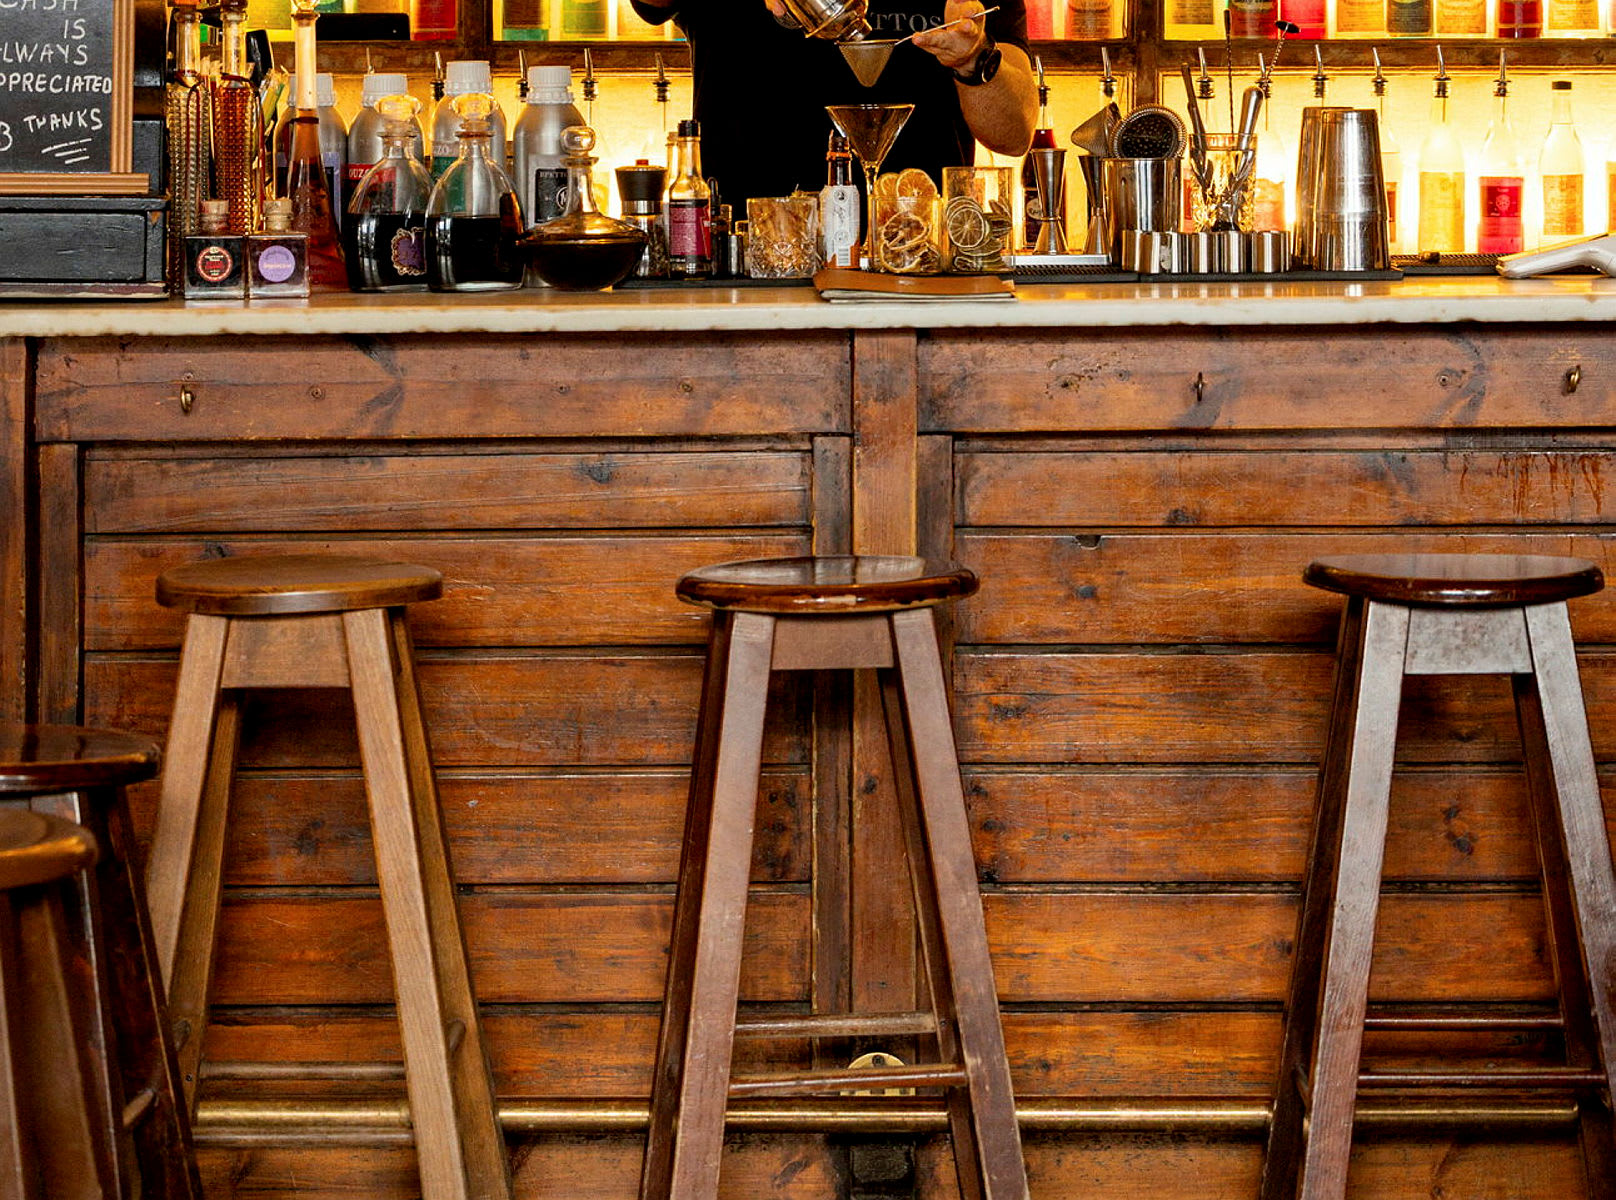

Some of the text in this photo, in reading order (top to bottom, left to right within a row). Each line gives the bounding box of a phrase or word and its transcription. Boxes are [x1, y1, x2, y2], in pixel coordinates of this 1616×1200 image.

[64, 18, 86, 40] IS
[869, 11, 942, 33] TTOS
[0, 42, 88, 65] LWAYS
[0, 72, 112, 94] PPRECIATED
[23, 108, 103, 133] THANKS
